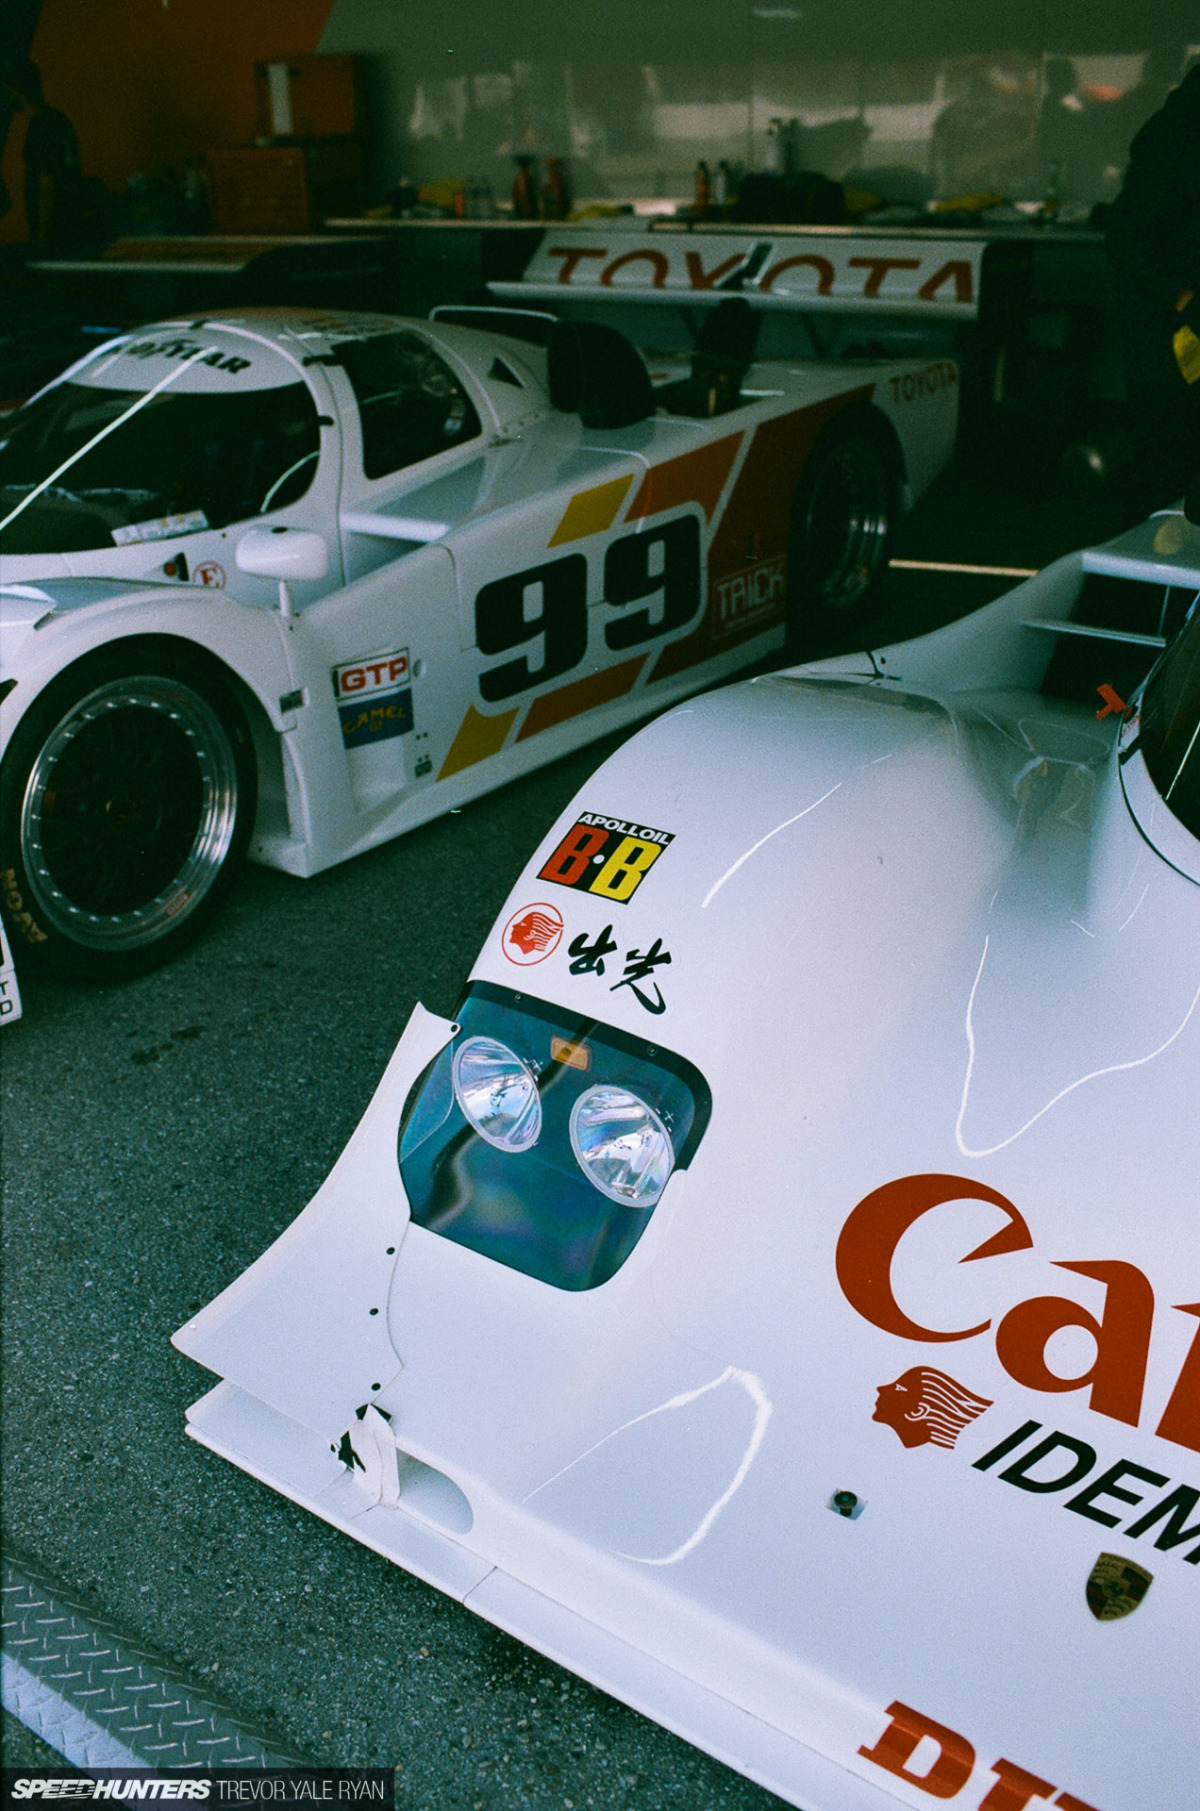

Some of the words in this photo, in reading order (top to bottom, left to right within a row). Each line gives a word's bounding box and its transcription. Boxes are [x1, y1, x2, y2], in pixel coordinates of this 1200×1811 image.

[889, 362, 957, 404] TOYOTA
[475, 514, 701, 702] 99
[341, 656, 408, 692] GTP
[343, 706, 406, 734] CAMEL
[578, 813, 670, 845] APOLLOIL
